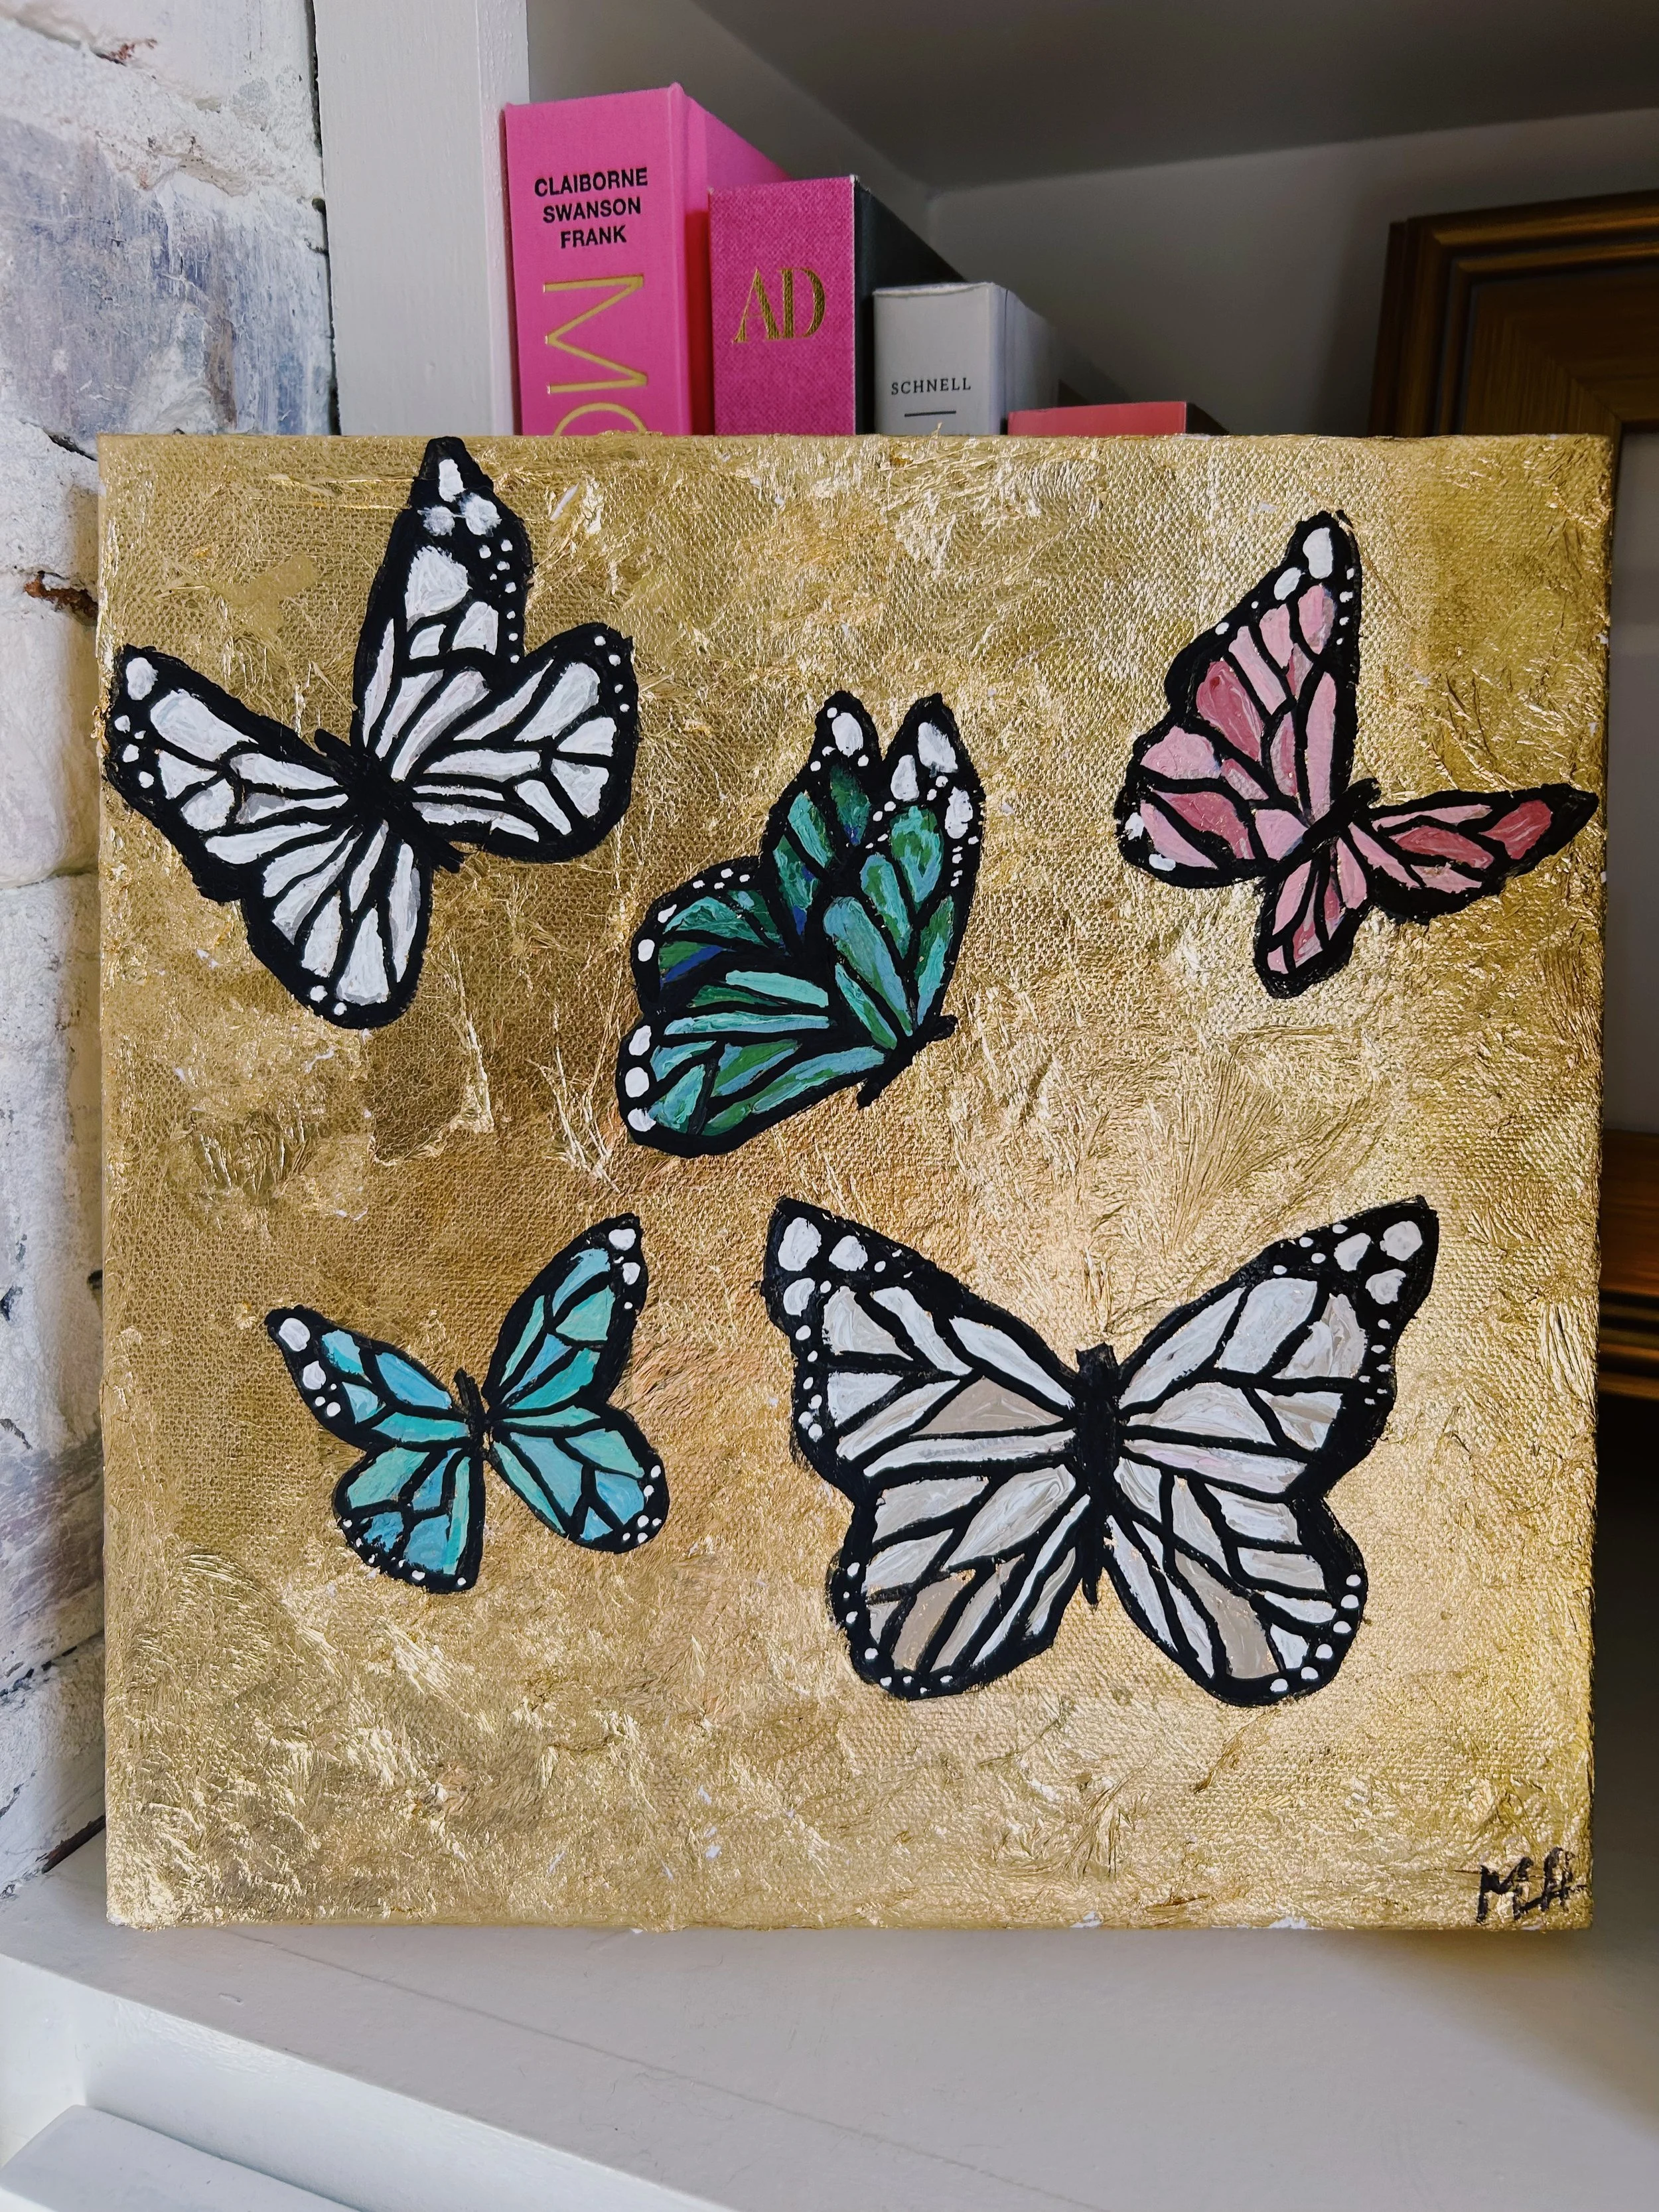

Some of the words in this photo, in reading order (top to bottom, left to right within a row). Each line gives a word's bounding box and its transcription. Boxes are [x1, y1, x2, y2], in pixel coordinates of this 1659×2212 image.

[534, 167, 648, 197] CLAIBORNE
[543, 196, 641, 224] SWANSON
[560, 224, 627, 249] FRANK
[731, 266, 826, 344] AD
[891, 377, 972, 396] SCHNELL
